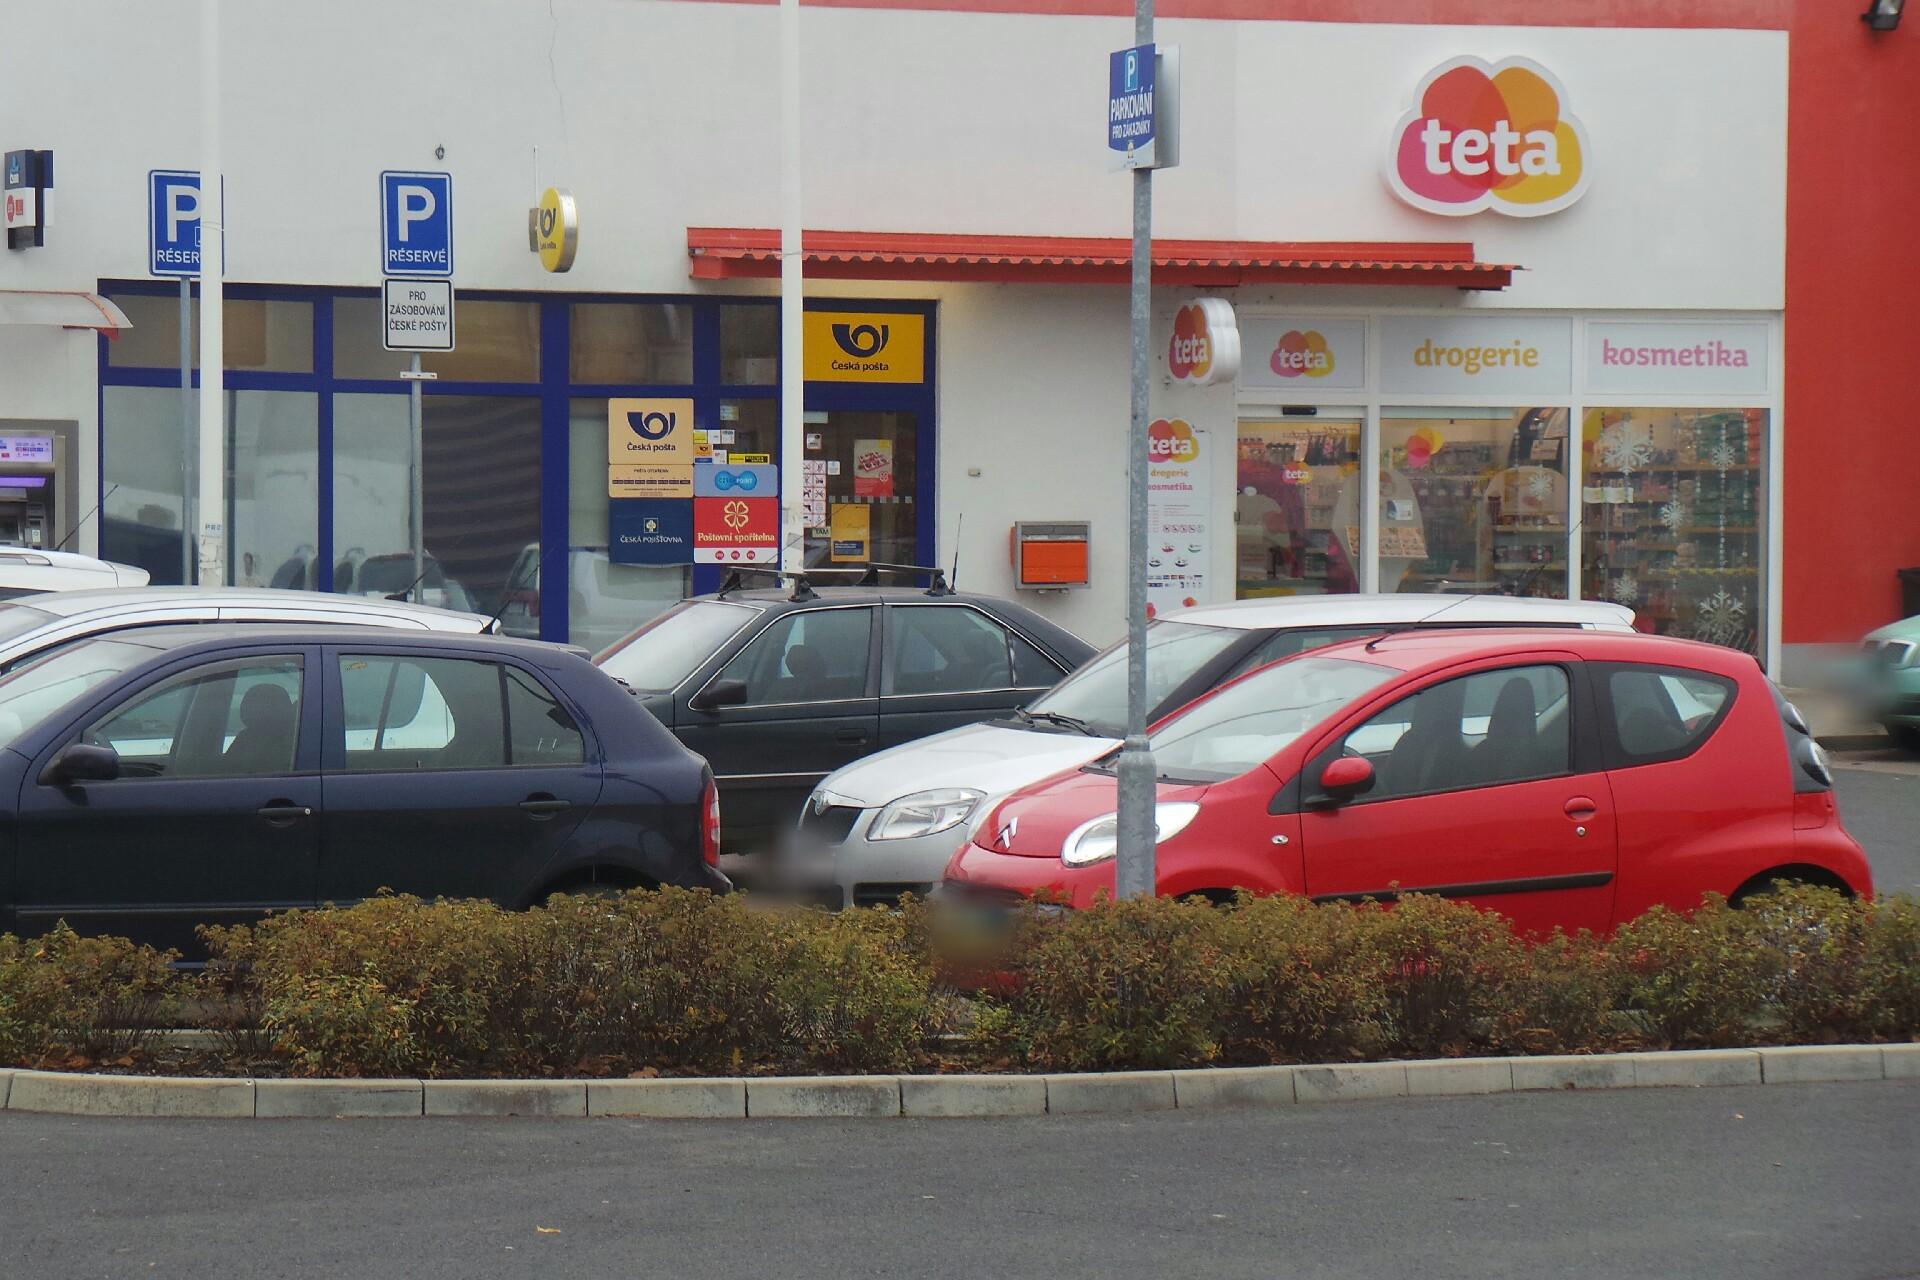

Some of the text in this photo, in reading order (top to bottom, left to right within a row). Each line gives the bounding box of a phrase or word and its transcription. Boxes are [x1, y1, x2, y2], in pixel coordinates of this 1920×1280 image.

[1110, 84, 1153, 122] PARKOVÁNÍ
[1112, 116, 1151, 139] PRO ZÁKAZNÍKY
[1420, 118, 1561, 176] teta
[397, 185, 436, 242] P
[156, 247, 200, 264] RÉSER
[389, 248, 448, 264] RÉSERVÉ
[408, 290, 427, 301] PRO
[389, 303, 446, 316] ZÁSOBOVÁNÍ
[389, 319, 448, 332] ČESKÉ POŠTY
[1174, 333, 1209, 364] teta
[1413, 338, 1539, 375] drogerie
[1602, 338, 1749, 367] kosmetika
[831, 359, 889, 372] Česká pošta
[1279, 348, 1329, 369] teta
[626, 441, 676, 453] Česká pošta
[1148, 435, 1193, 455] teta
[1150, 468, 1189, 479] drogerie
[619, 534, 642, 543] ČESKÁ
[697, 532, 775, 544] Poštovní spořitelna
